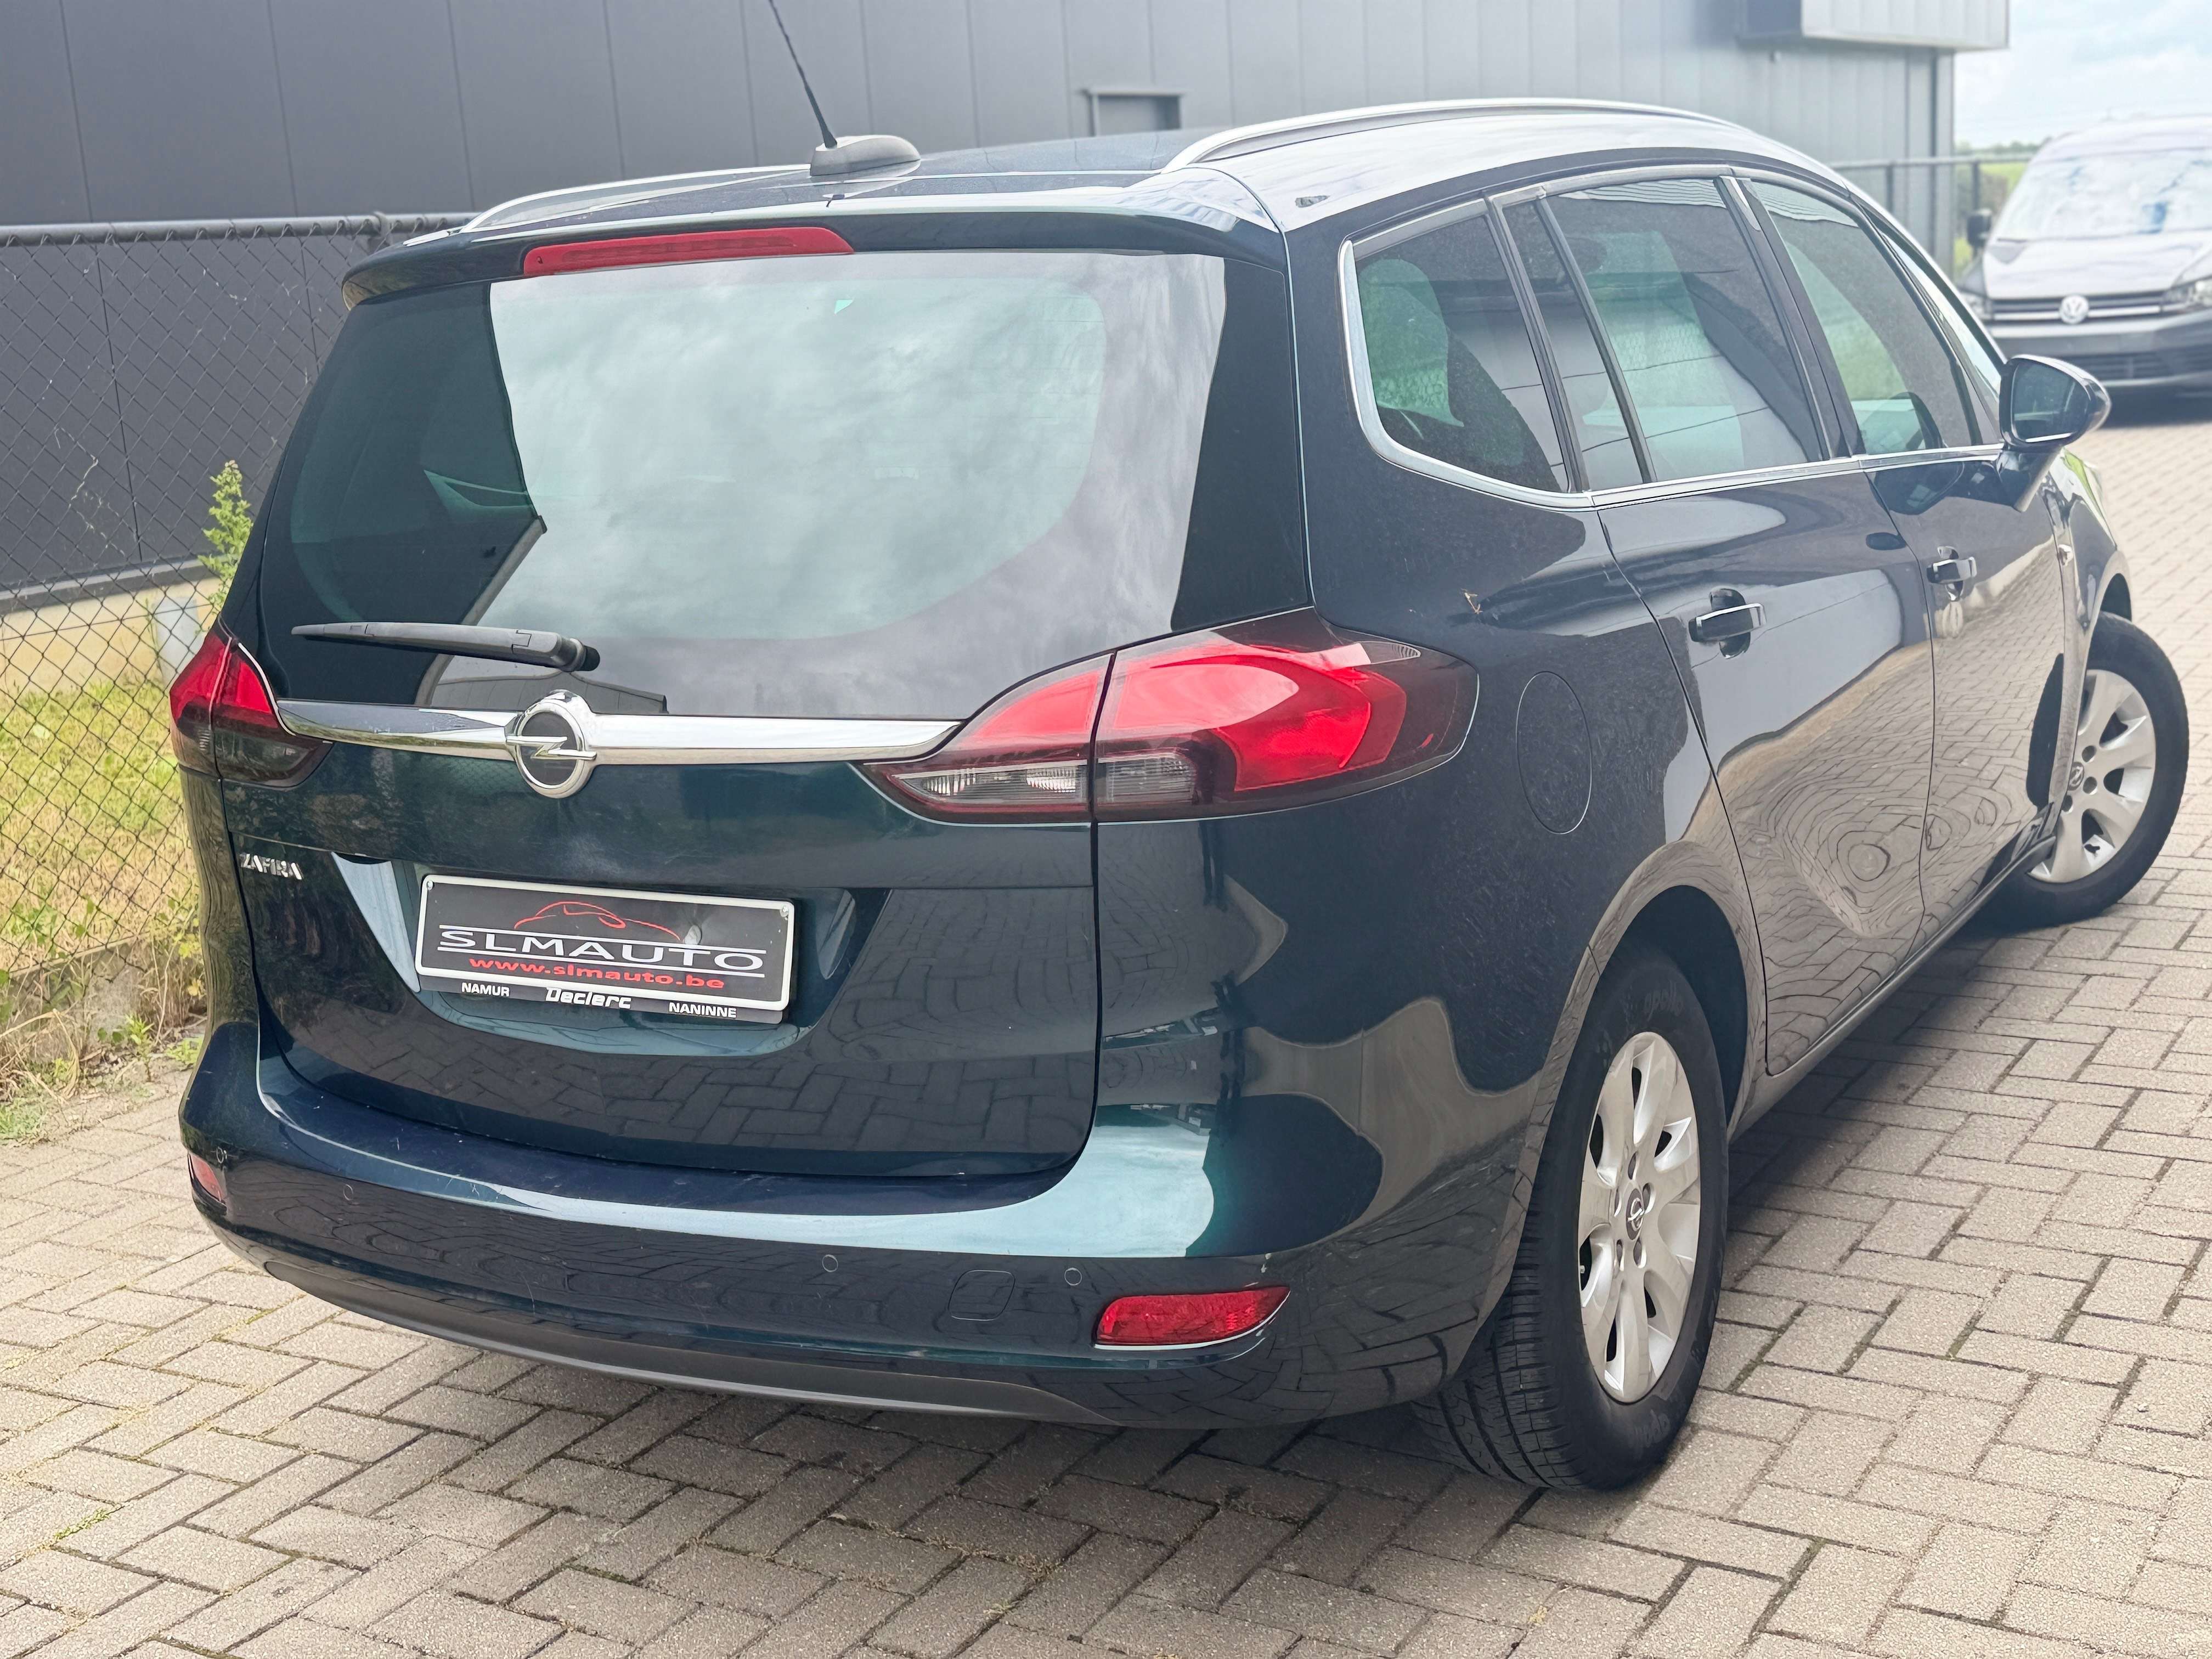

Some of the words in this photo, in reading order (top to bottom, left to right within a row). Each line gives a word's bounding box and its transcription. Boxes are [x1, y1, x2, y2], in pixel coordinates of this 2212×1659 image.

[239, 853, 304, 880] ZAFIRA
[439, 929, 764, 972] SLMAUTO
[469, 958, 725, 989] www.slmauto.be
[461, 981, 510, 997] NAMUR
[668, 1001, 737, 1018] NANINNE
